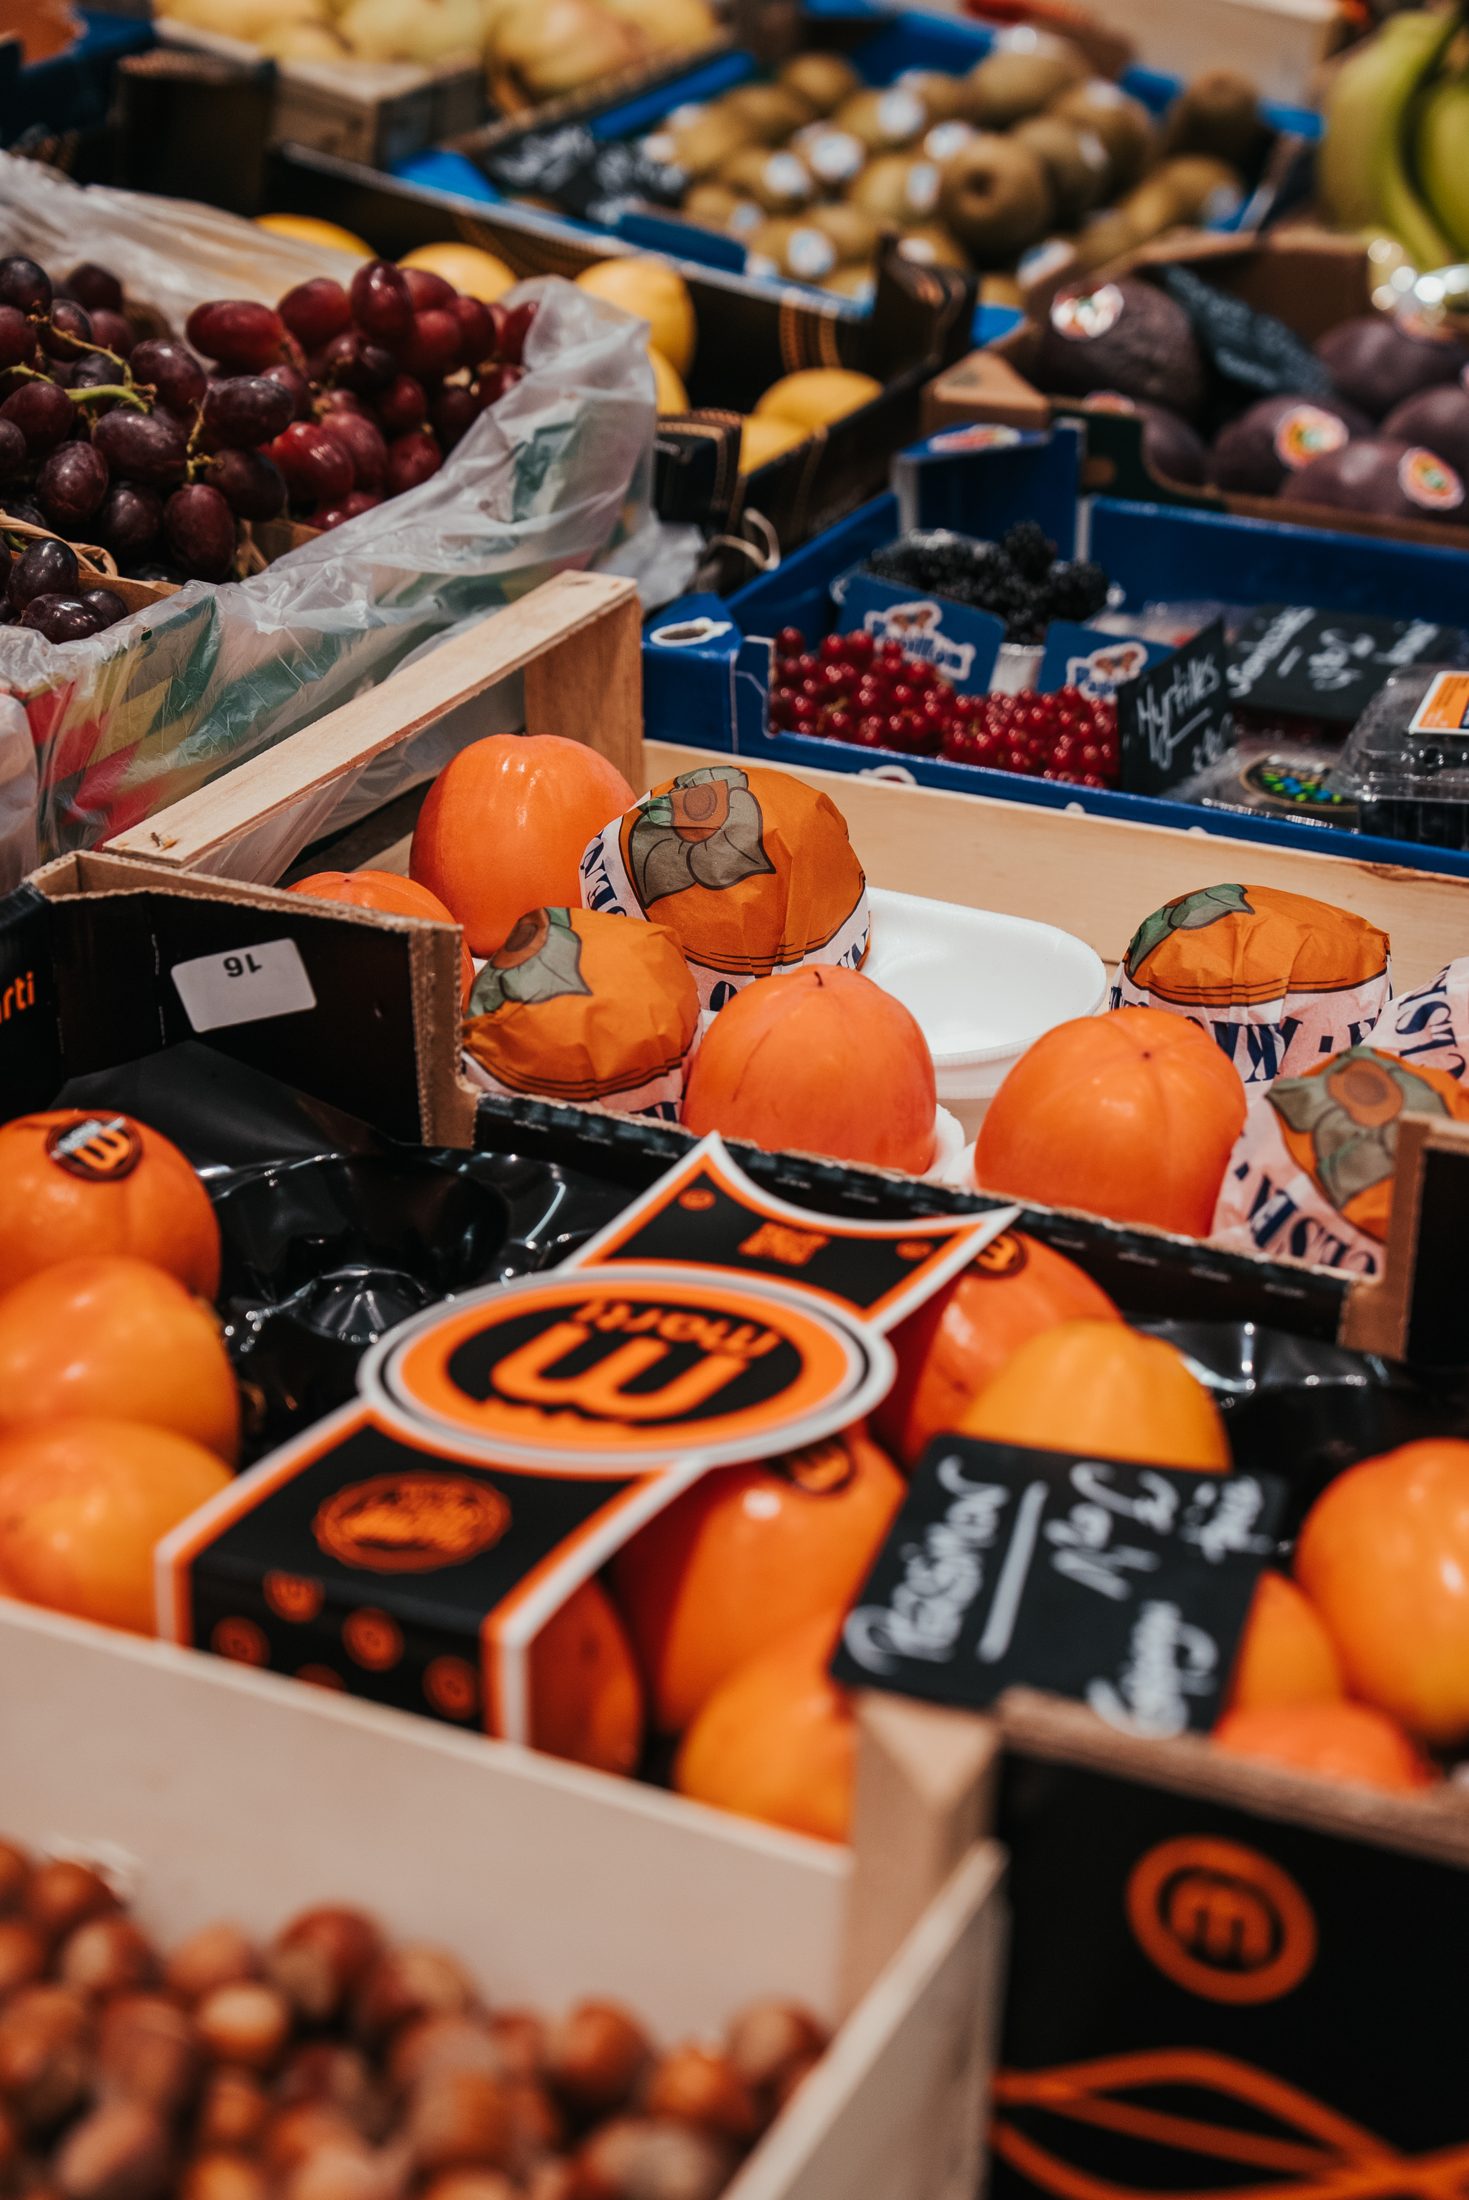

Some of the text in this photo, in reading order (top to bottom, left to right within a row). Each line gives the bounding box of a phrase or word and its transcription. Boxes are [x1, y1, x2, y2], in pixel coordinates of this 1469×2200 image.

[223, 953, 263, 978] 16
[0, 970, 35, 1023] rti
[570, 1300, 784, 1359] morti
